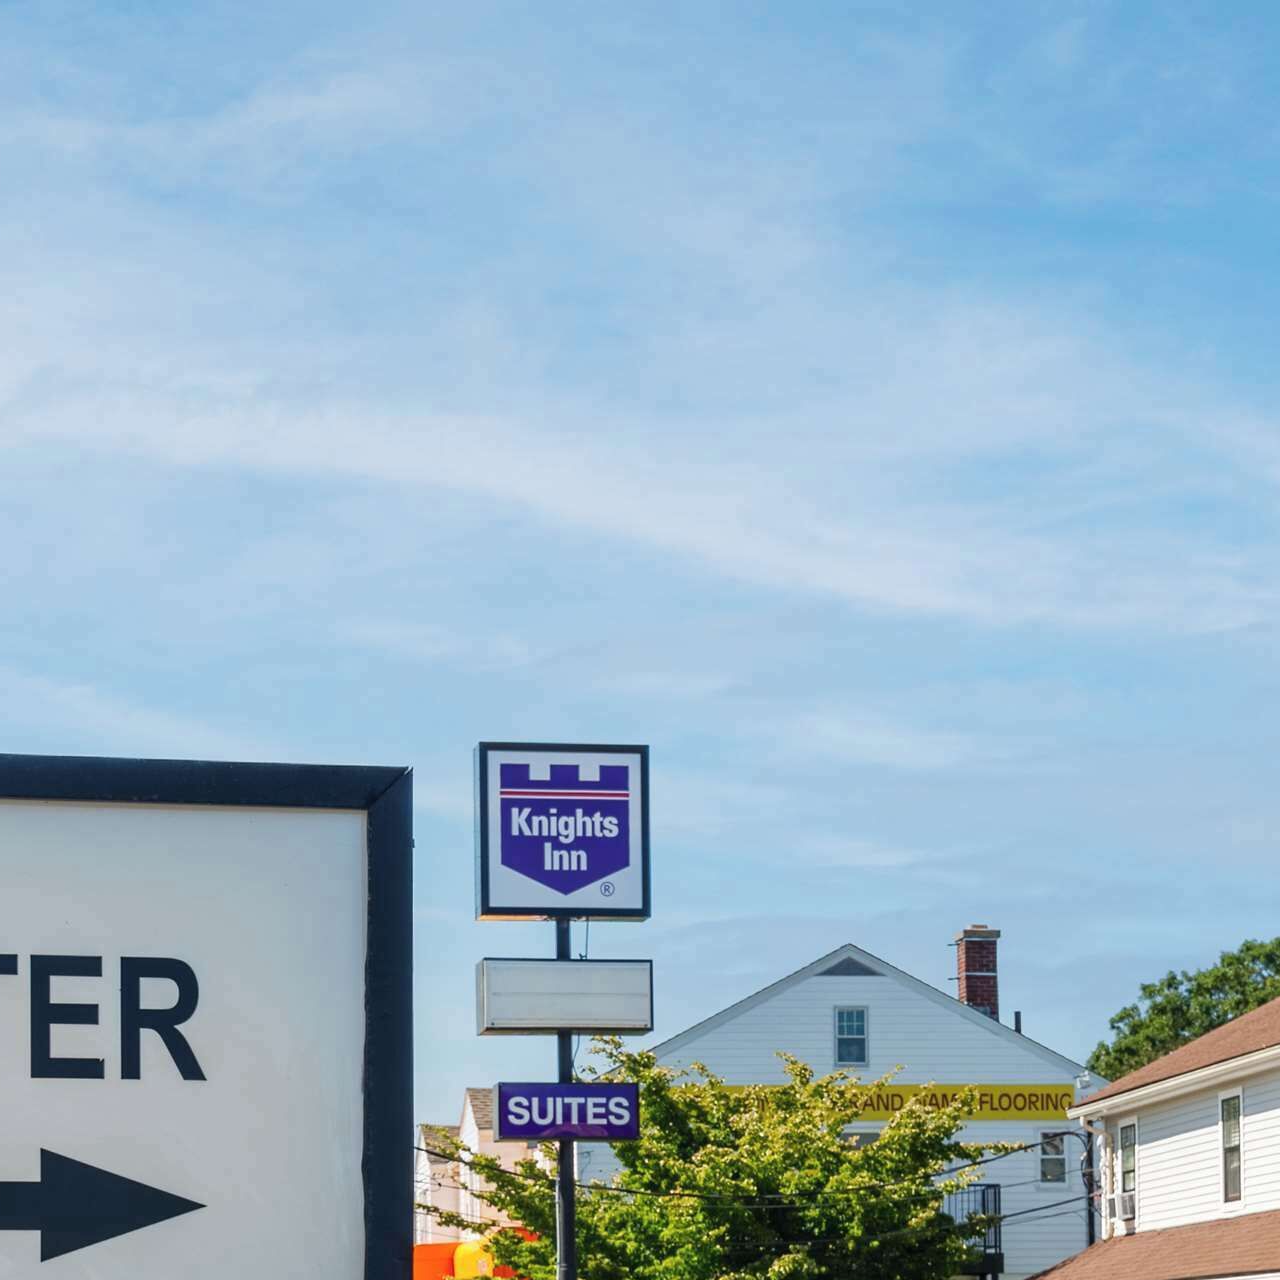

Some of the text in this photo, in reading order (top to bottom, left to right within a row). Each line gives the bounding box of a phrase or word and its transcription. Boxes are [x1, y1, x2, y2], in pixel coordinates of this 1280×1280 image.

[511, 807, 619, 843] Knights
[543, 842, 587, 871] Inn
[507, 1096, 631, 1126] SUITES
[978, 1093, 1072, 1112] FLOORING
